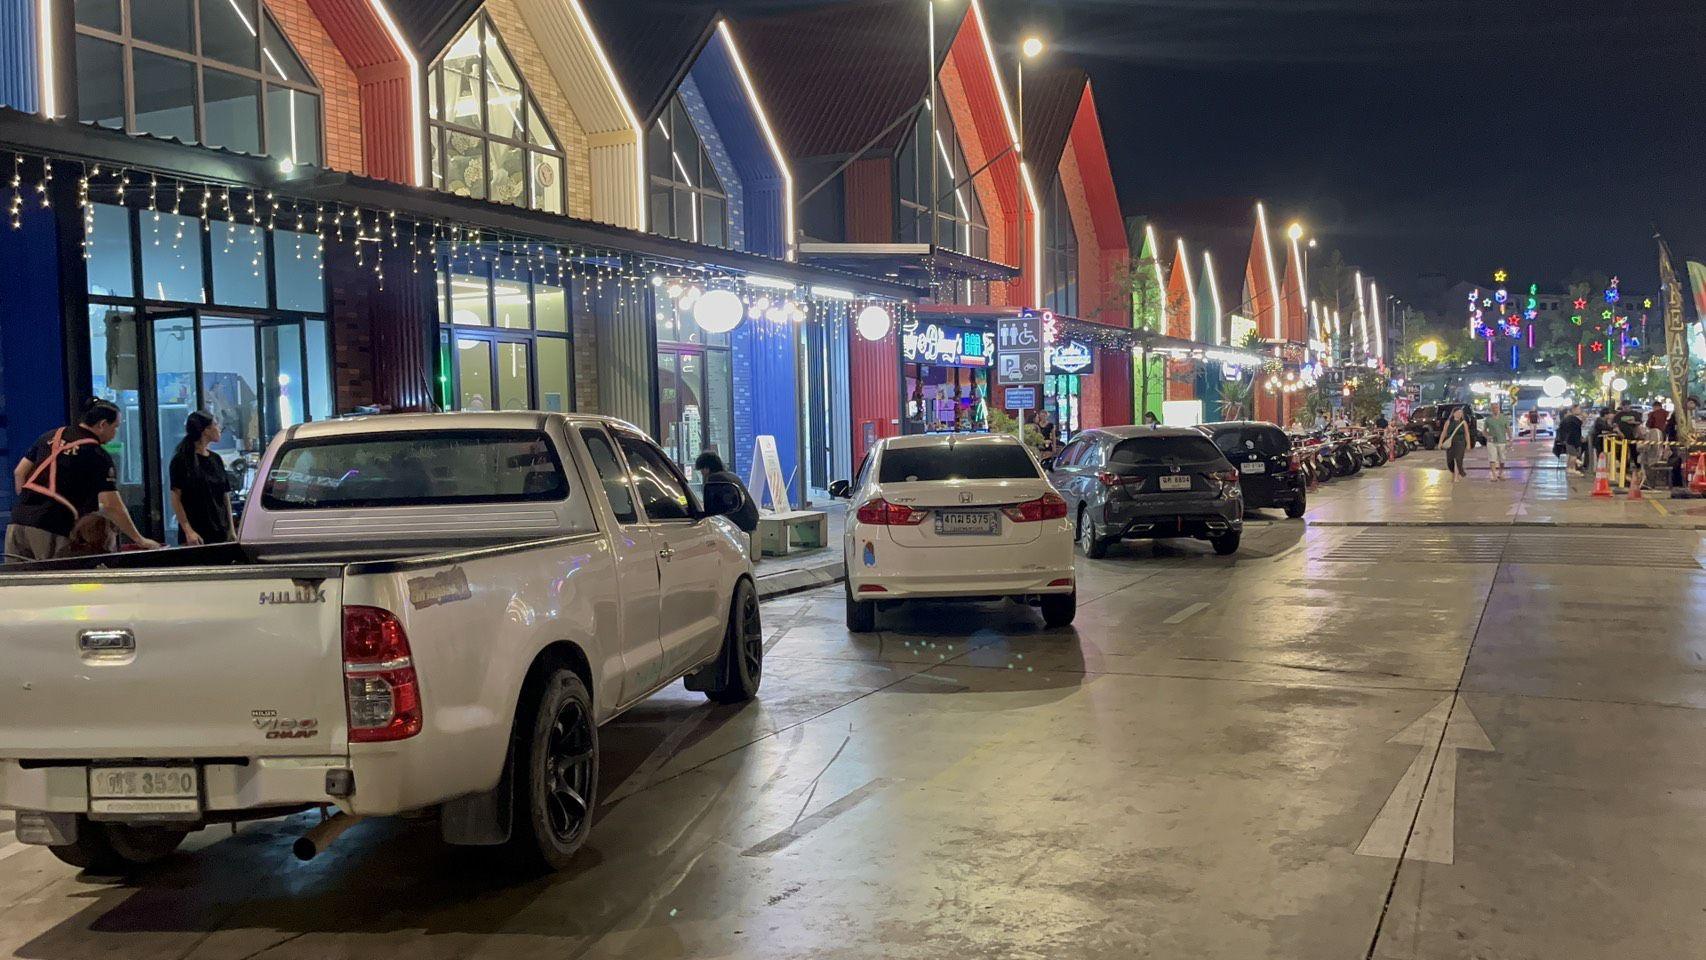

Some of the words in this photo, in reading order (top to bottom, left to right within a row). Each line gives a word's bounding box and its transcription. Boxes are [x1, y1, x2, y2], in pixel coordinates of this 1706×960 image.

[966, 514, 989, 525] 5375
[258, 589, 327, 605] HILUX
[141, 772, 193, 794] 3520
